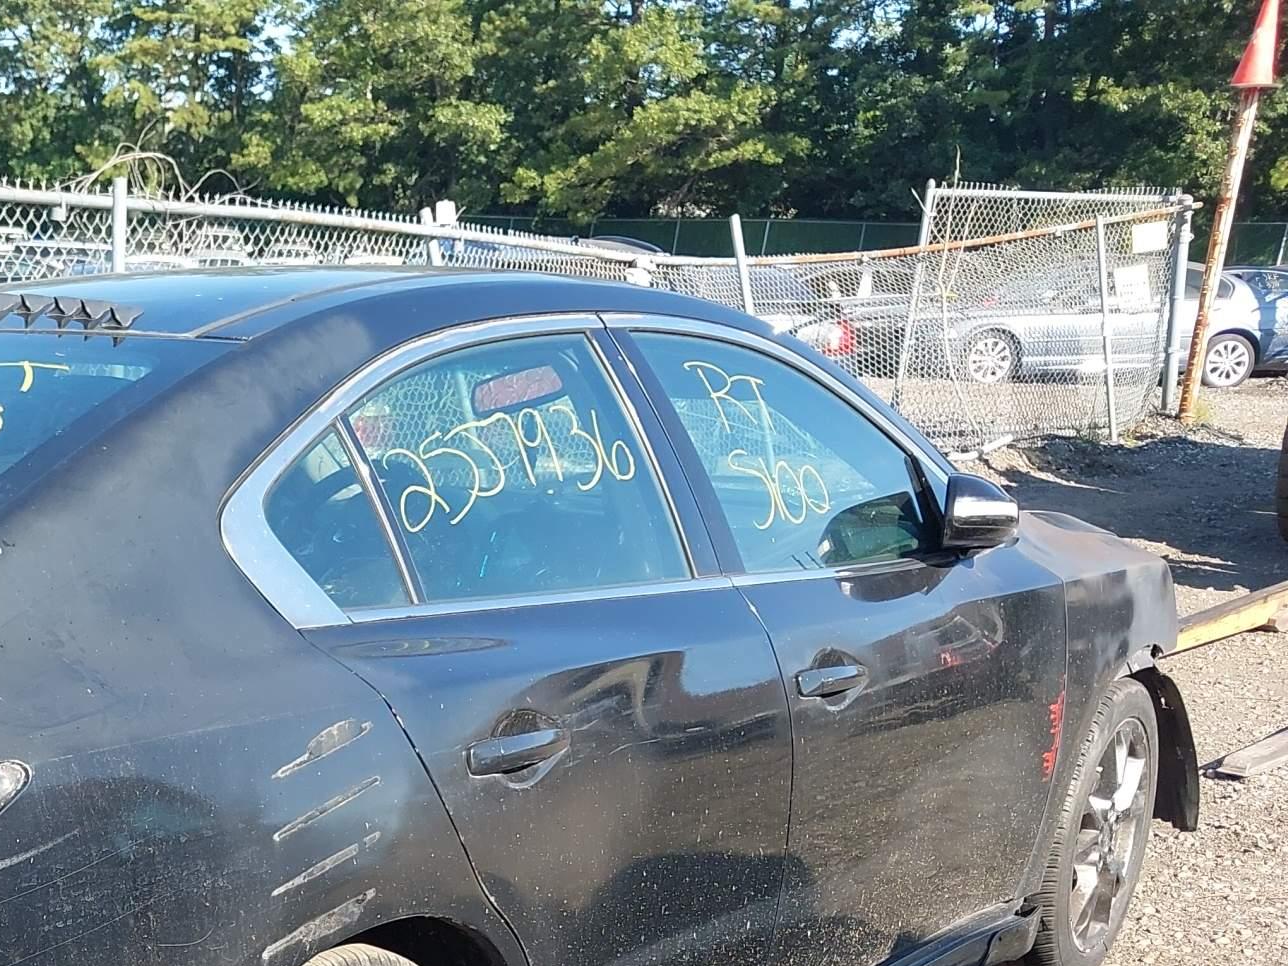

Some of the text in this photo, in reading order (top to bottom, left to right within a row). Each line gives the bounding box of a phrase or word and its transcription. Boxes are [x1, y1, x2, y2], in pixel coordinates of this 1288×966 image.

[683, 361, 777, 435] RT
[383, 407, 635, 532] 2557936
[728, 448, 832, 530] S100
